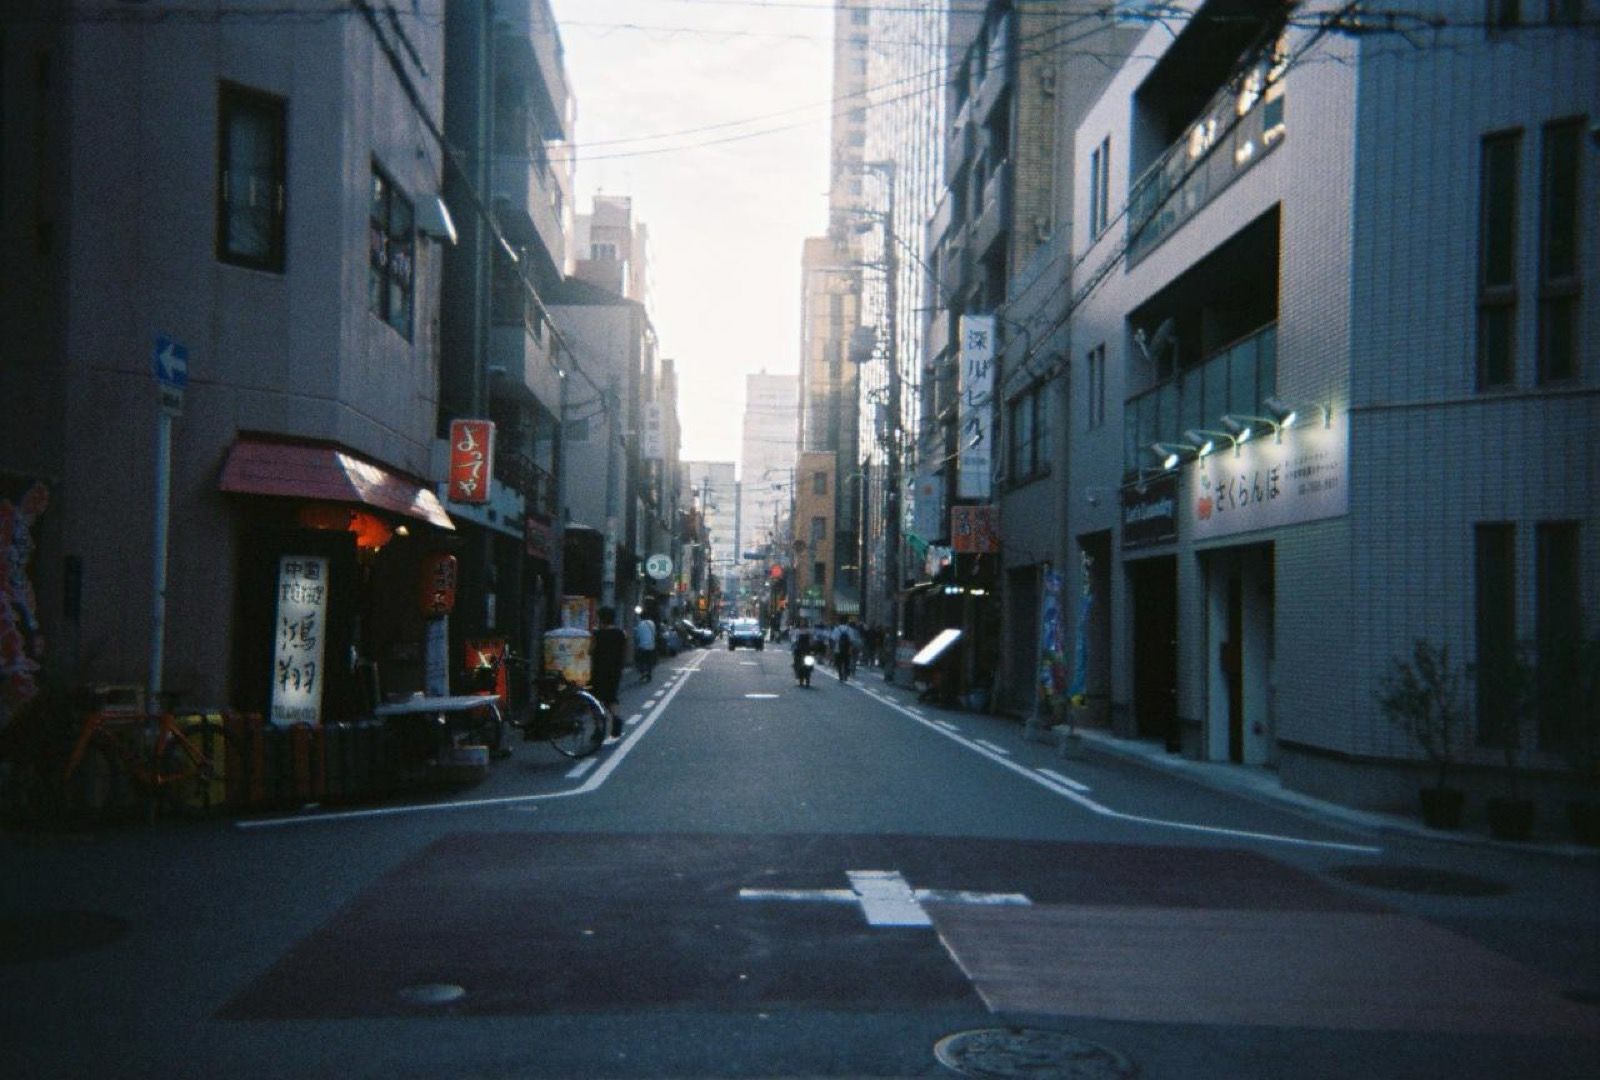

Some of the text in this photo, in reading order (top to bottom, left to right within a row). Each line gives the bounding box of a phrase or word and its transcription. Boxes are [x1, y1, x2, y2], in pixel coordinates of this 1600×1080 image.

[457, 426, 483, 495] よってや
[1216, 464, 1281, 512] さくらんぼ
